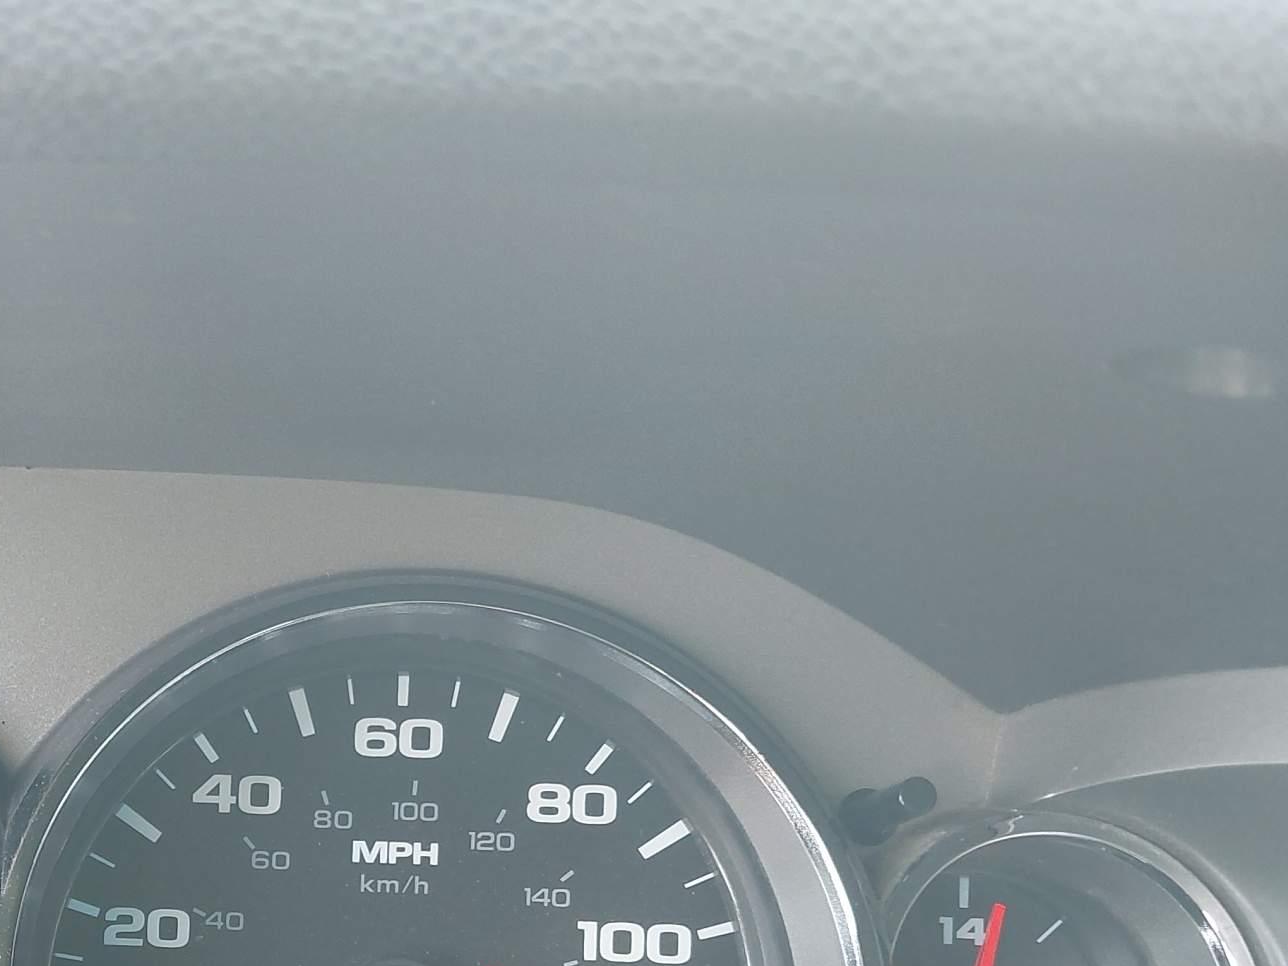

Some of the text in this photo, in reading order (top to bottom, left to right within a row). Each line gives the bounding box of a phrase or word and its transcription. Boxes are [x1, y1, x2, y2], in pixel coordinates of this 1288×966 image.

[355, 718, 443, 758] 60
[193, 775, 283, 814] 40
[527, 783, 617, 824] 80
[314, 810, 352, 828] 80
[392, 802, 438, 821] 100
[469, 832, 515, 851] 120
[252, 851, 290, 869] 60
[352, 841, 438, 865] MPH
[361, 874, 428, 894] km/h
[524, 888, 570, 907] 140
[104, 908, 190, 947] 20
[206, 912, 244, 930] 40
[940, 917, 988, 946] 14
[578, 921, 691, 964] 100
